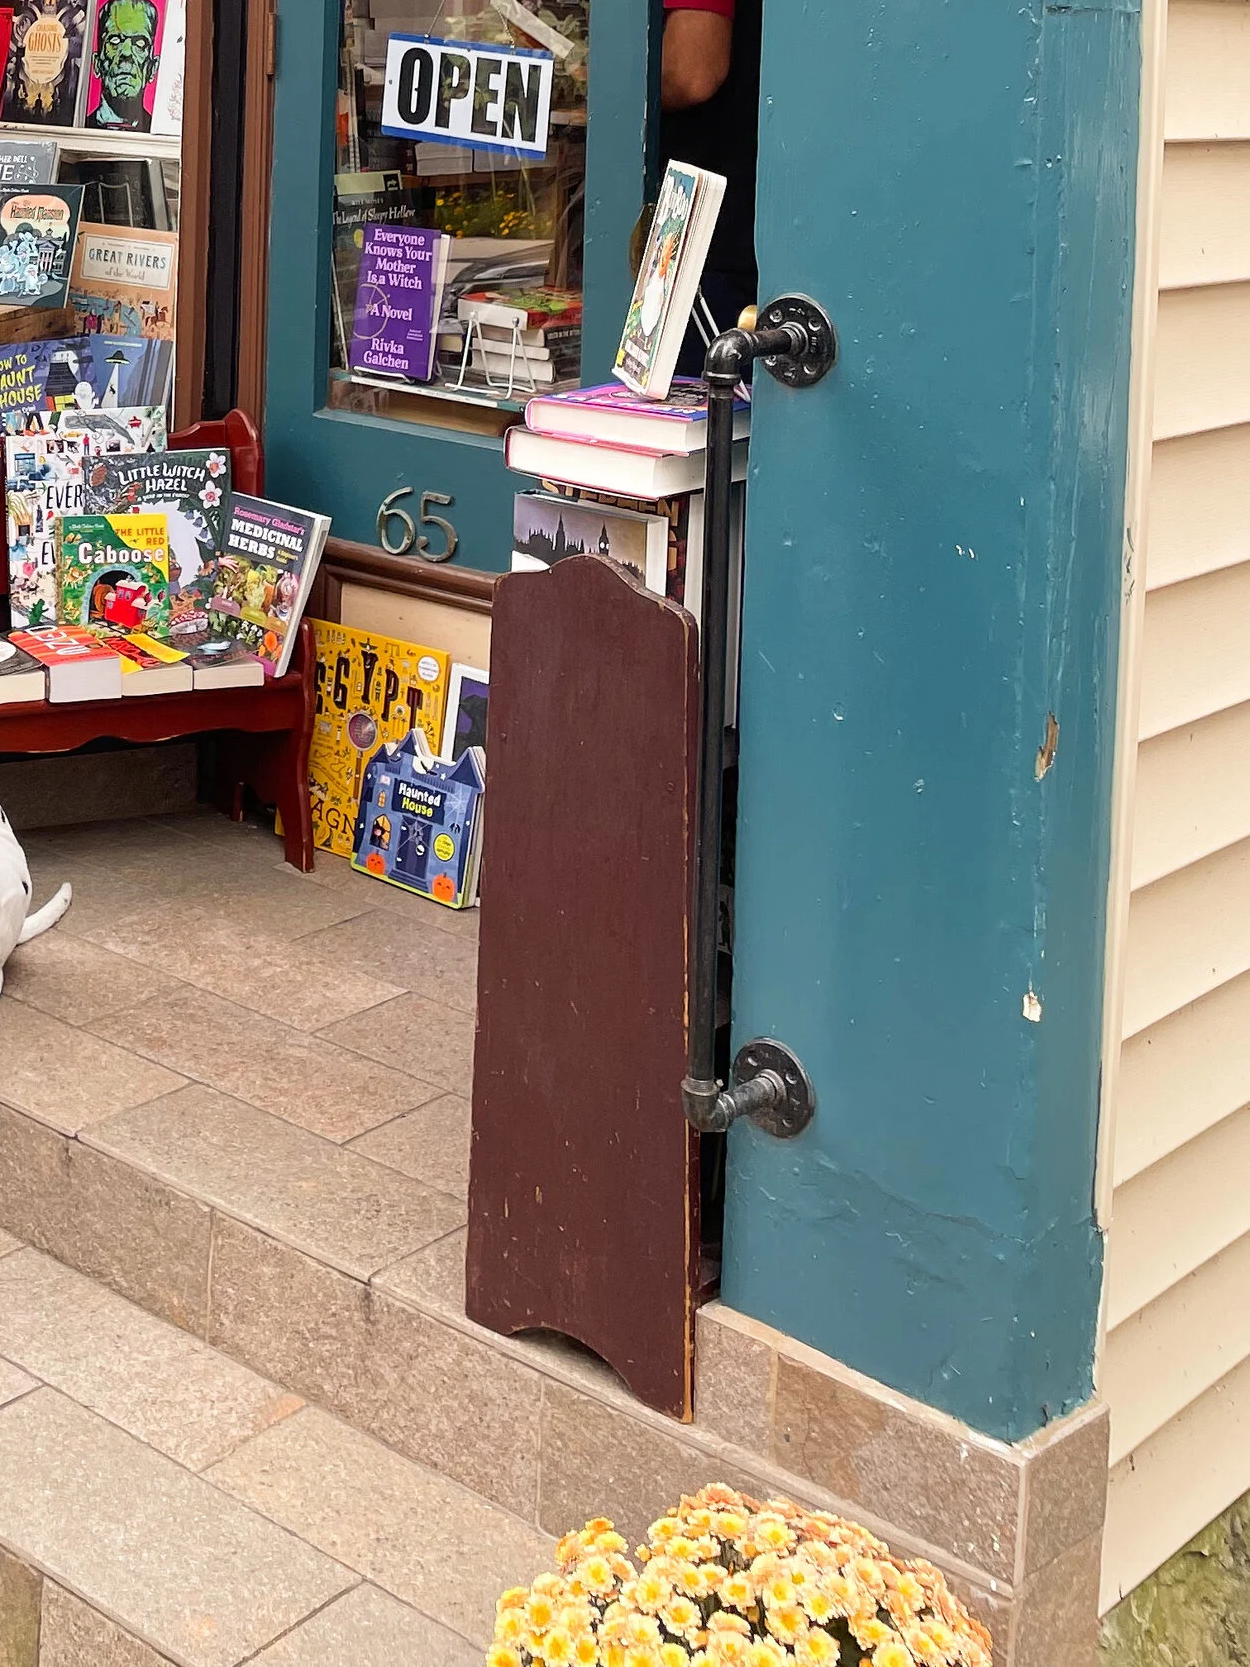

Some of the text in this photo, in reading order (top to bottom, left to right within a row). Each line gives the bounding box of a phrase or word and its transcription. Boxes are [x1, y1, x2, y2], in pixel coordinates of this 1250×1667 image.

[28, 32, 62, 53] GHOSTS
[396, 47, 543, 144] OPEN
[10, 204, 37, 220] Haunted
[342, 209, 362, 229] Legend
[367, 207, 388, 225] Sleepy
[388, 204, 416, 220] Hollow
[374, 228, 425, 247] Everyone
[89, 247, 167, 270] GREAT RIVERS
[364, 241, 433, 262] Knows Your
[375, 257, 416, 274] Mother
[367, 270, 423, 290] Is a Witch
[369, 304, 413, 321] A Novel
[371, 337, 405, 355] Rivka
[15, 353, 28, 367] TO
[363, 350, 409, 370] Galchen
[117, 461, 207, 485] LITTLE WITCH
[145, 477, 188, 493] HAZEL
[233, 505, 305, 536] Rosemary Gladstar's
[375, 486, 459, 563] 65
[115, 527, 165, 537] THE LITTLE
[146, 536, 165, 546] RED
[230, 518, 304, 553] MEDICINAL
[77, 541, 166, 565] Caboose
[227, 533, 276, 560] HERBS
[398, 782, 442, 808] Haunted
[400, 796, 434, 818] House
